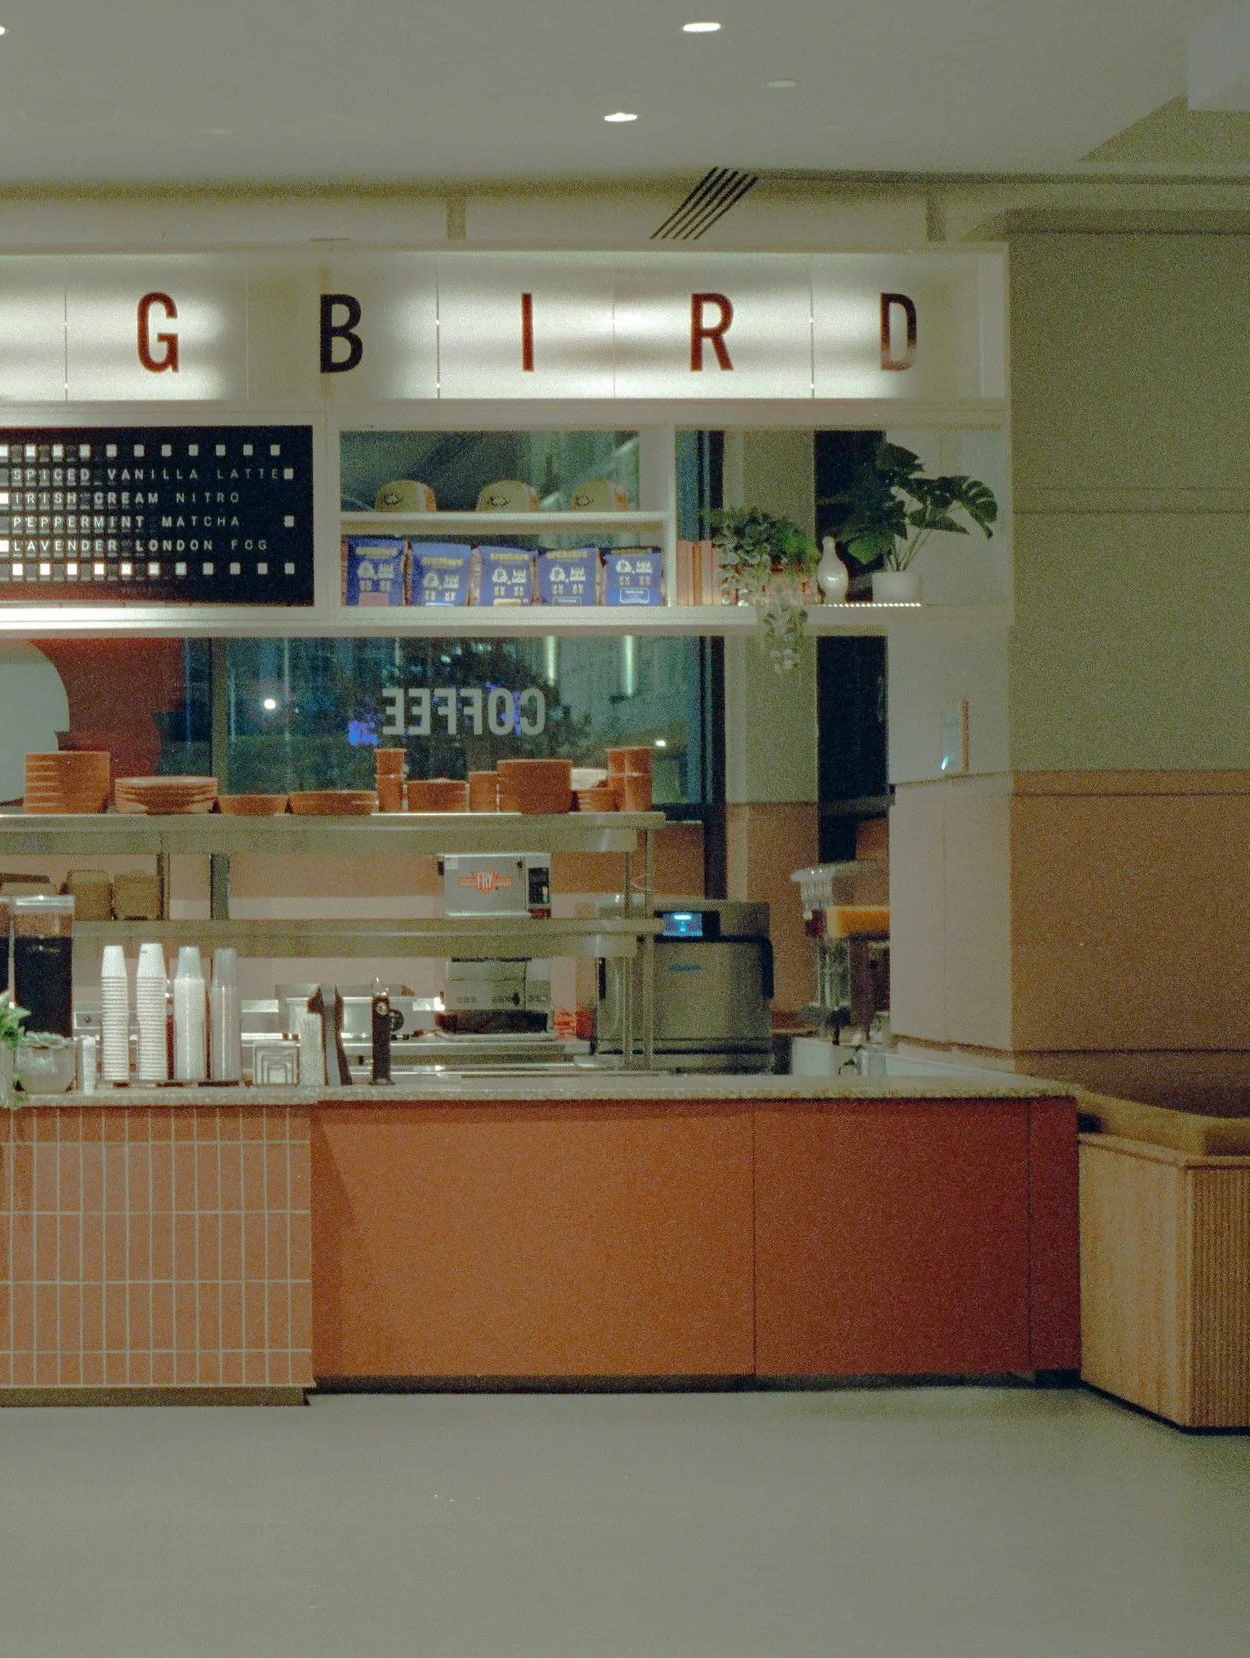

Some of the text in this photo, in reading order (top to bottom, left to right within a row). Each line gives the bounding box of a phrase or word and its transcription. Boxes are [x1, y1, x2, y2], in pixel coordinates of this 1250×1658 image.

[13, 468, 279, 480] SPICED VANILLA LATTE
[14, 492, 239, 504] IRISH CREAM NITRO
[13, 516, 240, 528] PEPPERMINT MATCHA
[13, 539, 267, 551] LAVENDER LONDON FOG
